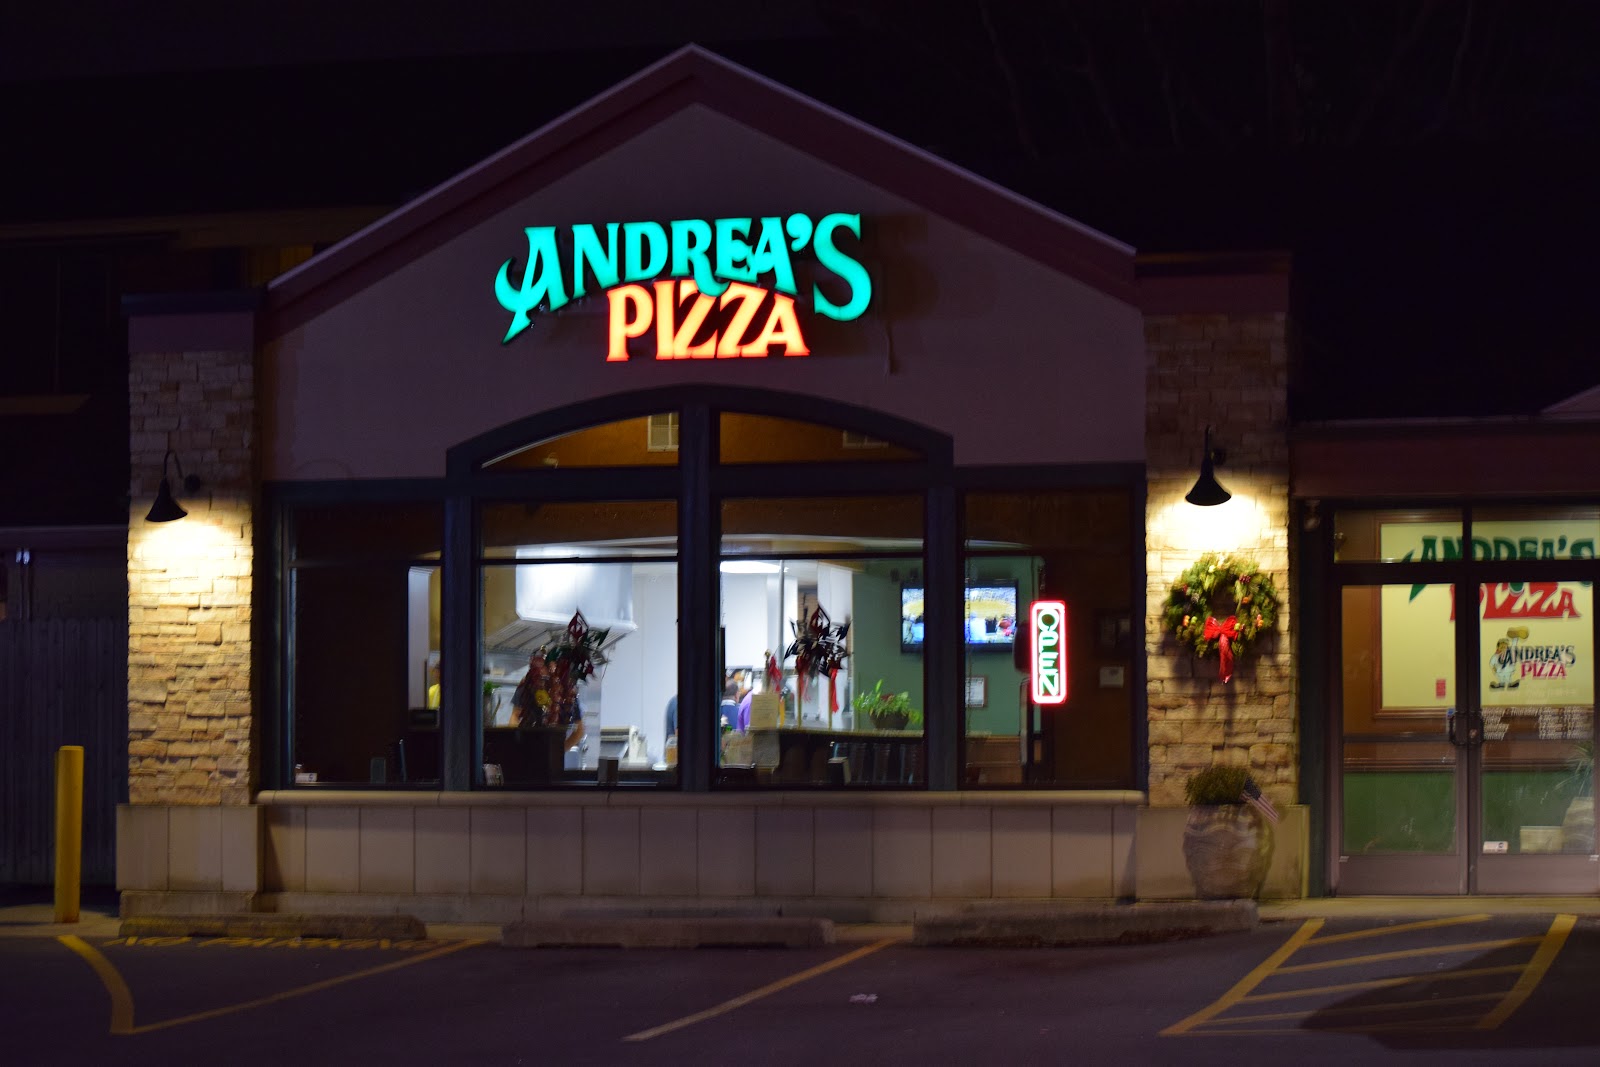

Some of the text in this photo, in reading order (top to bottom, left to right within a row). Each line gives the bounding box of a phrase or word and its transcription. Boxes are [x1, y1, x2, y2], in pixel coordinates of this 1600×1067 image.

[495, 212, 872, 343] ANDREA'S
[606, 279, 810, 361] PIZZA
[1037, 608, 1060, 697] OPEN
[1498, 644, 1576, 669] ANDREA'S
[1520, 660, 1567, 679] PIZZA
